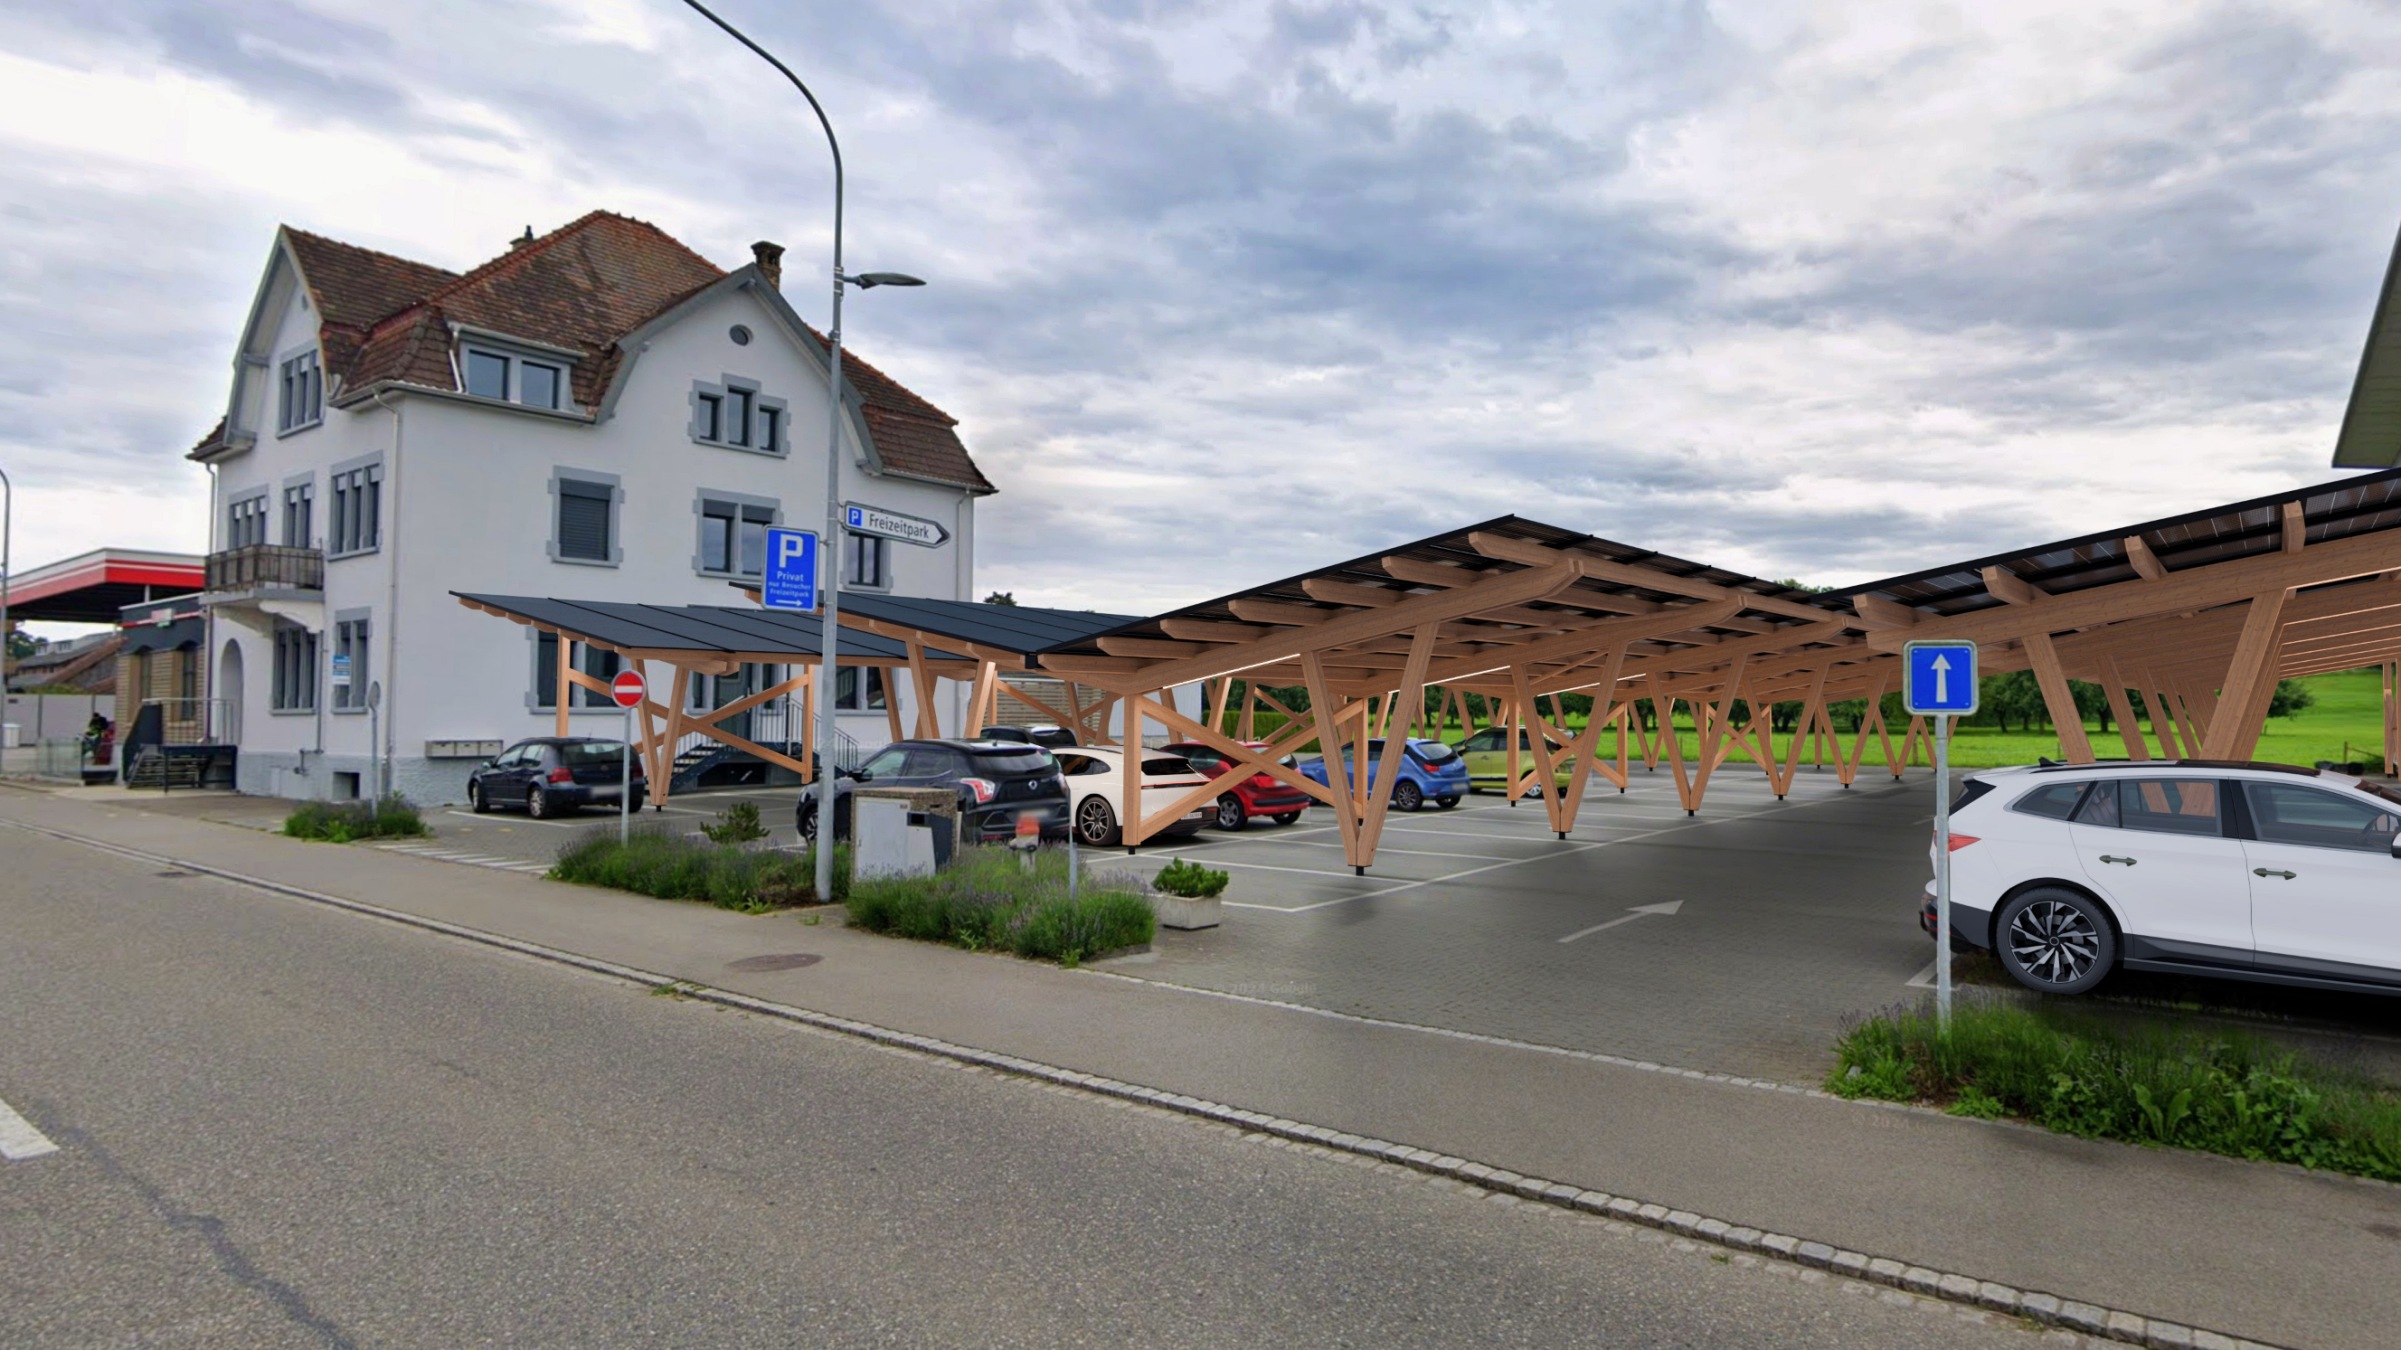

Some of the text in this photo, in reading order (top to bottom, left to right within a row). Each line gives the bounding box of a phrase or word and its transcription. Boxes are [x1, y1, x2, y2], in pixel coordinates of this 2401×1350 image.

[851, 510, 929, 538] P Freizeitpark
[779, 533, 804, 568] P
[777, 571, 804, 582] Privat
